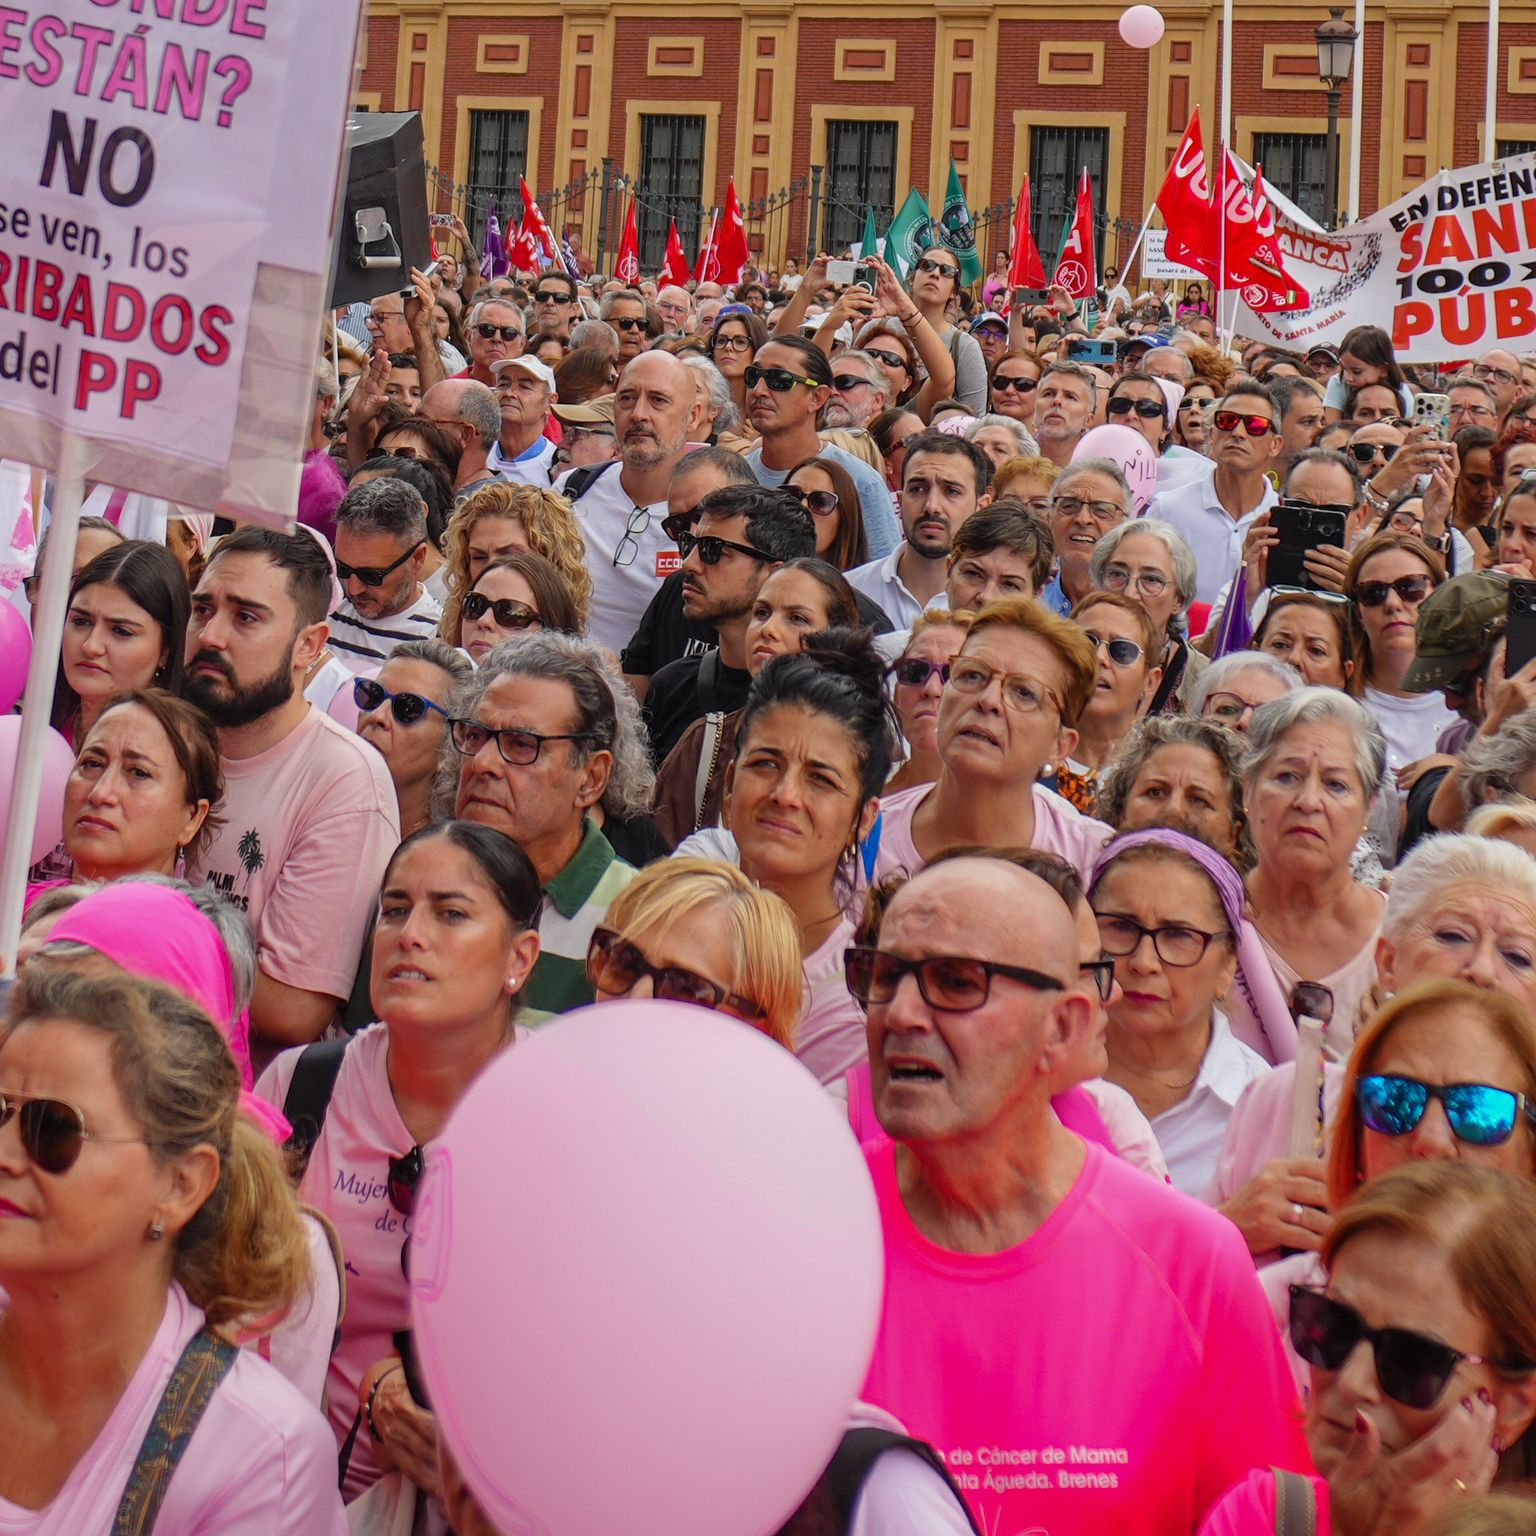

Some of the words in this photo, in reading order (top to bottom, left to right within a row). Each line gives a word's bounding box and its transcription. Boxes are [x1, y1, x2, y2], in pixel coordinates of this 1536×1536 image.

[39, 108, 156, 208] NO
[1175, 137, 1210, 201] UG
[1389, 194, 1430, 233] EN
[41, 212, 113, 271] ven,
[130, 227, 191, 279] los
[1276, 232, 1350, 274] ANCA
[1396, 260, 1512, 299] 100
[1271, 327, 1284, 340] DE
[1284, 326, 1315, 342] SANTA
[73, 348, 163, 420] PP
[658, 558, 683, 569] CCO
[207, 870, 236, 892] PALM
[375, 1208, 398, 1233] de
[949, 1447, 973, 1465] de
[977, 1445, 1038, 1465] Cáncer
[1041, 1446, 1066, 1465] de
[1069, 1445, 1129, 1465] Mama
[954, 1471, 980, 1490] nta
[983, 1466, 1055, 1494] Águeda.
[1057, 1470, 1119, 1489] Brenes
